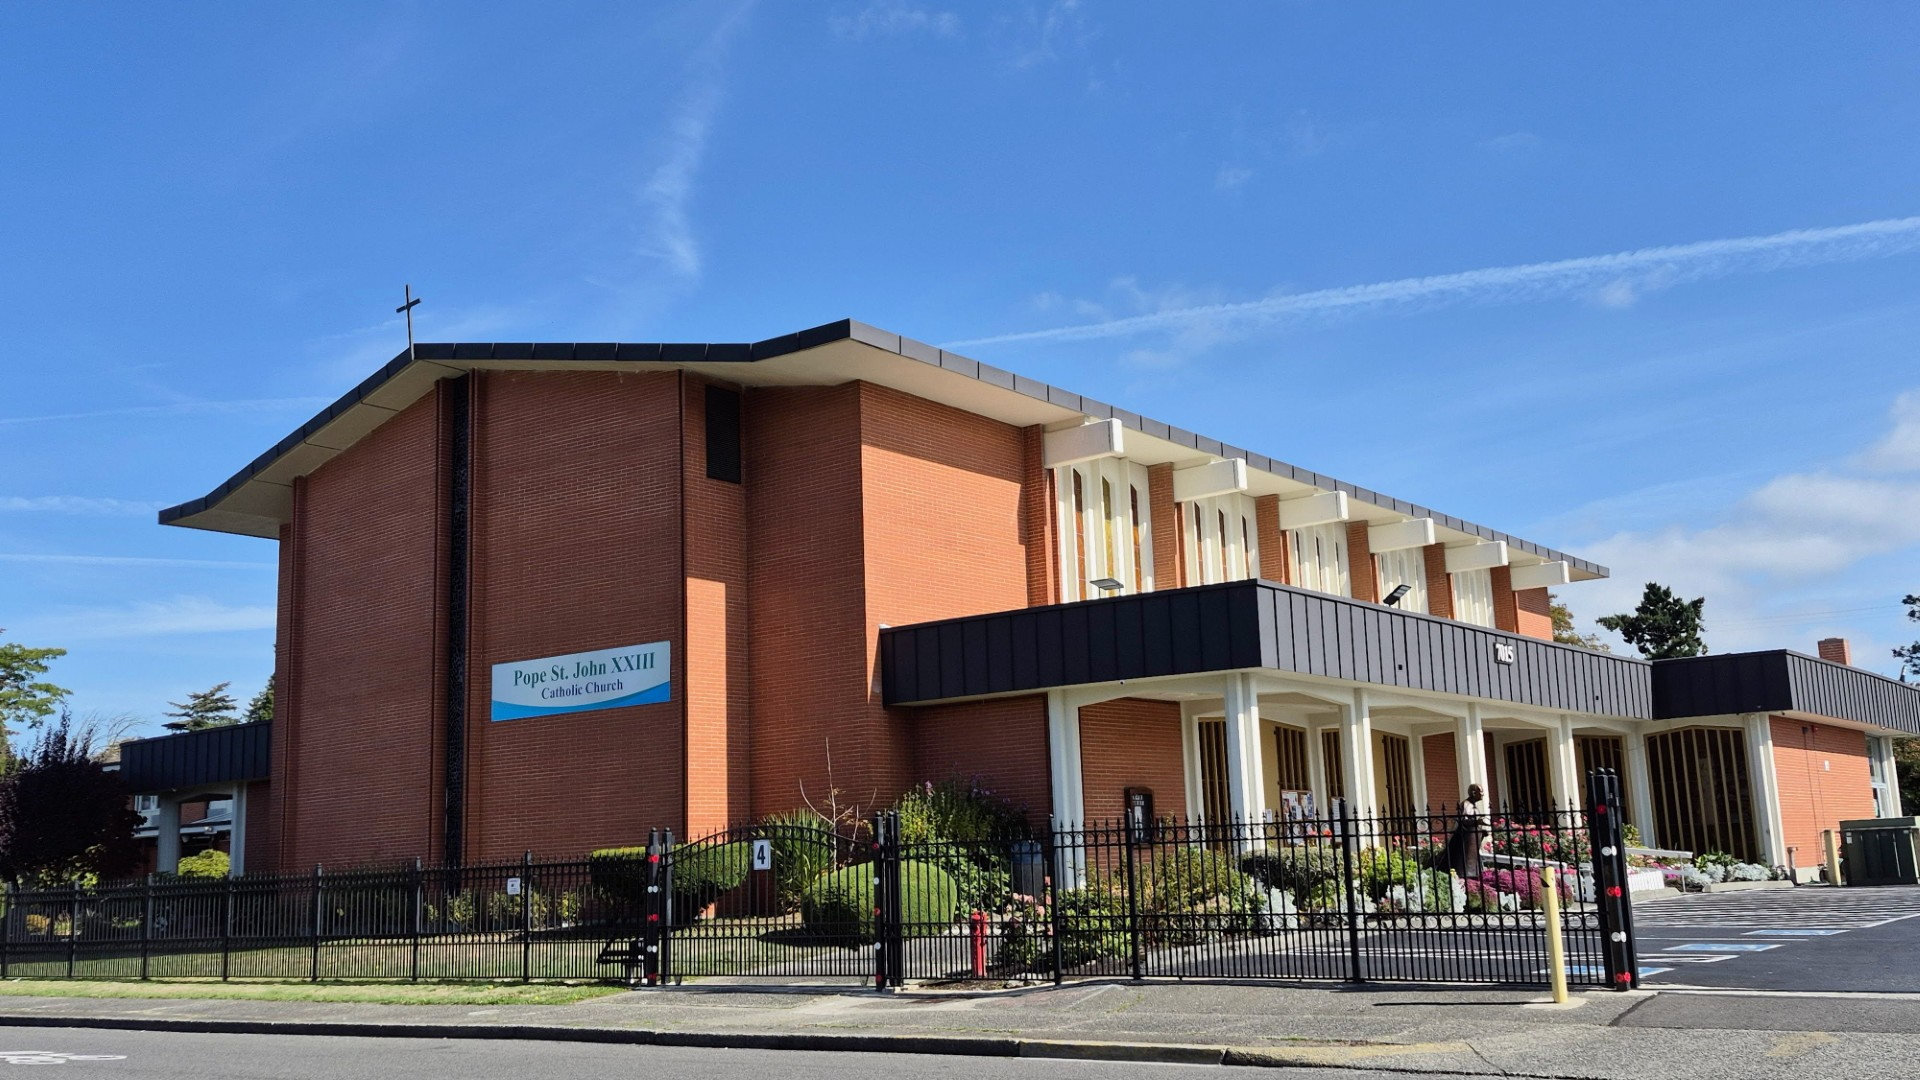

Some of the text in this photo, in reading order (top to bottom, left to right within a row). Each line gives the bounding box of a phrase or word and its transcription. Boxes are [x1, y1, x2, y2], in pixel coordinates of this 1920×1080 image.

[514, 652, 655, 688] Pope St. John XXIII
[541, 678, 624, 700] Catholic Church
[757, 844, 766, 865] 4
